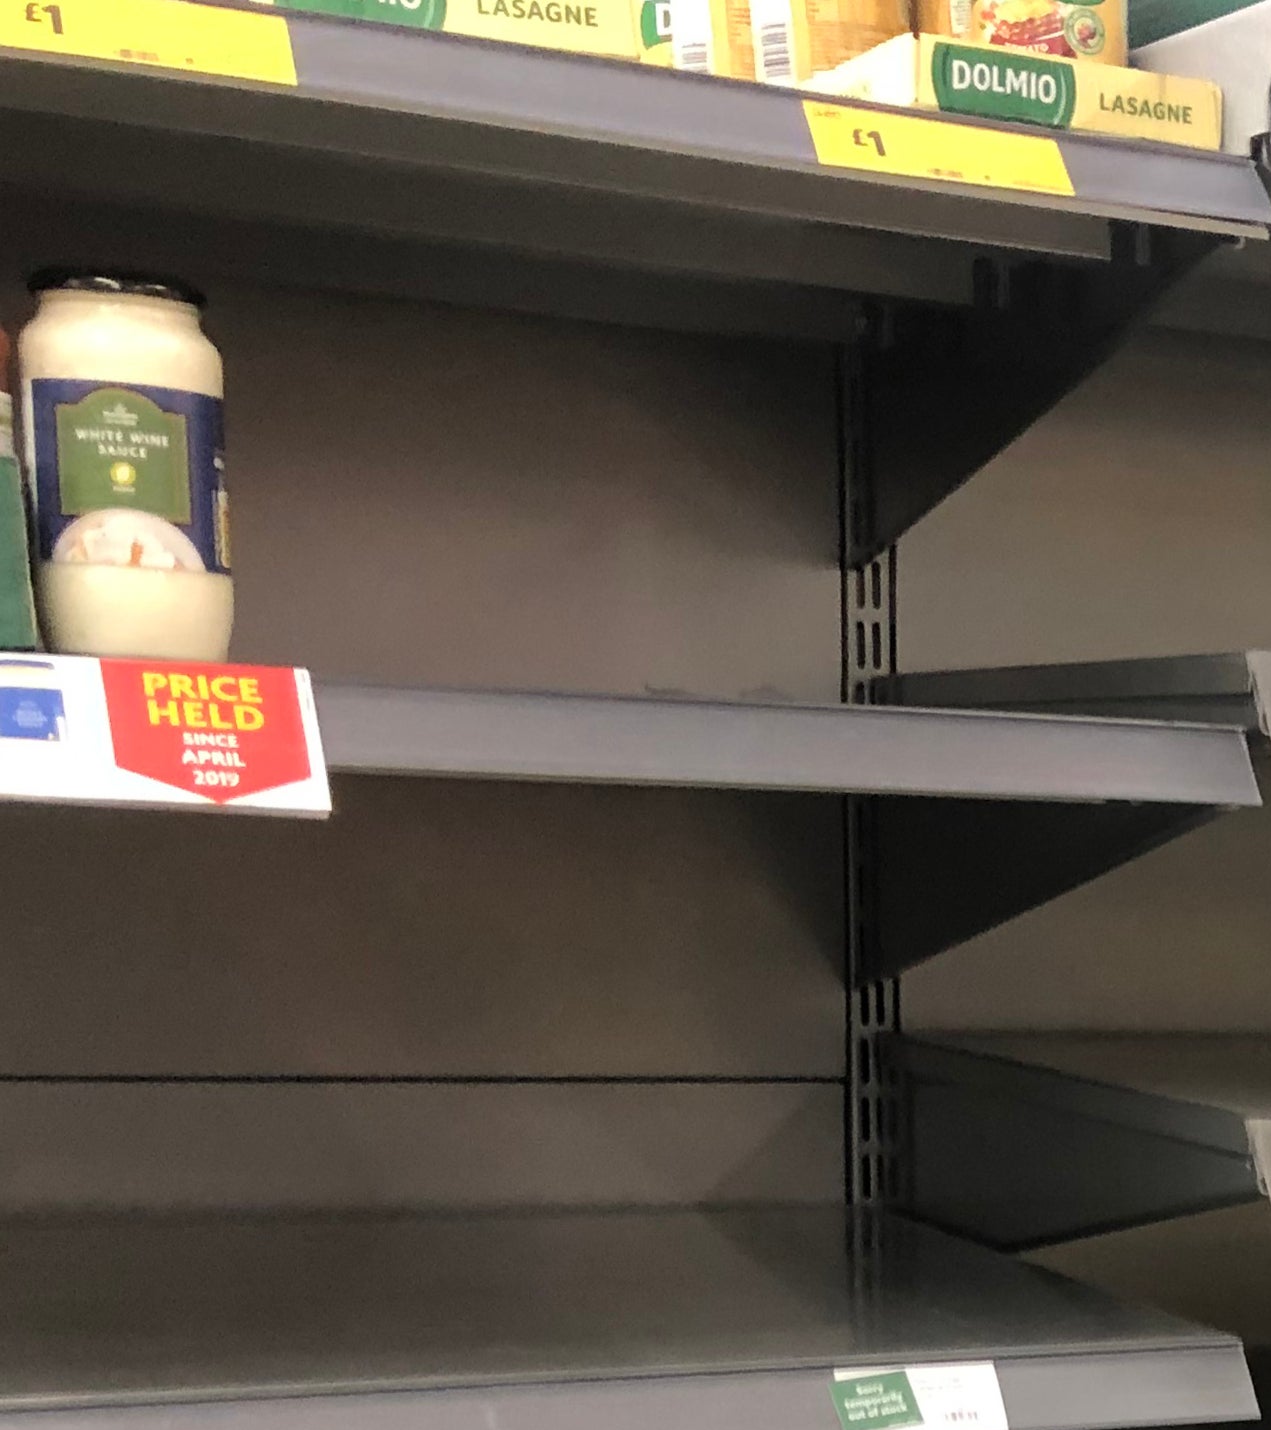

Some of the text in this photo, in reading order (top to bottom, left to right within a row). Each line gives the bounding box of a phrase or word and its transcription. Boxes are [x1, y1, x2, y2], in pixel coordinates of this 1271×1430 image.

[24, 2, 64, 35] £1
[476, 0, 599, 27] LASAGNE
[951, 59, 1057, 104] DOLMIO
[1099, 92, 1193, 125] LASAGNE
[853, 128, 887, 157] £1
[74, 427, 170, 448] WHITE WINE
[97, 441, 148, 459] SAUCE
[142, 671, 264, 704] PRICE
[147, 699, 266, 731] HELD
[182, 731, 240, 749] SINCE
[181, 748, 247, 768] APRIL
[192, 769, 241, 788] 2019
